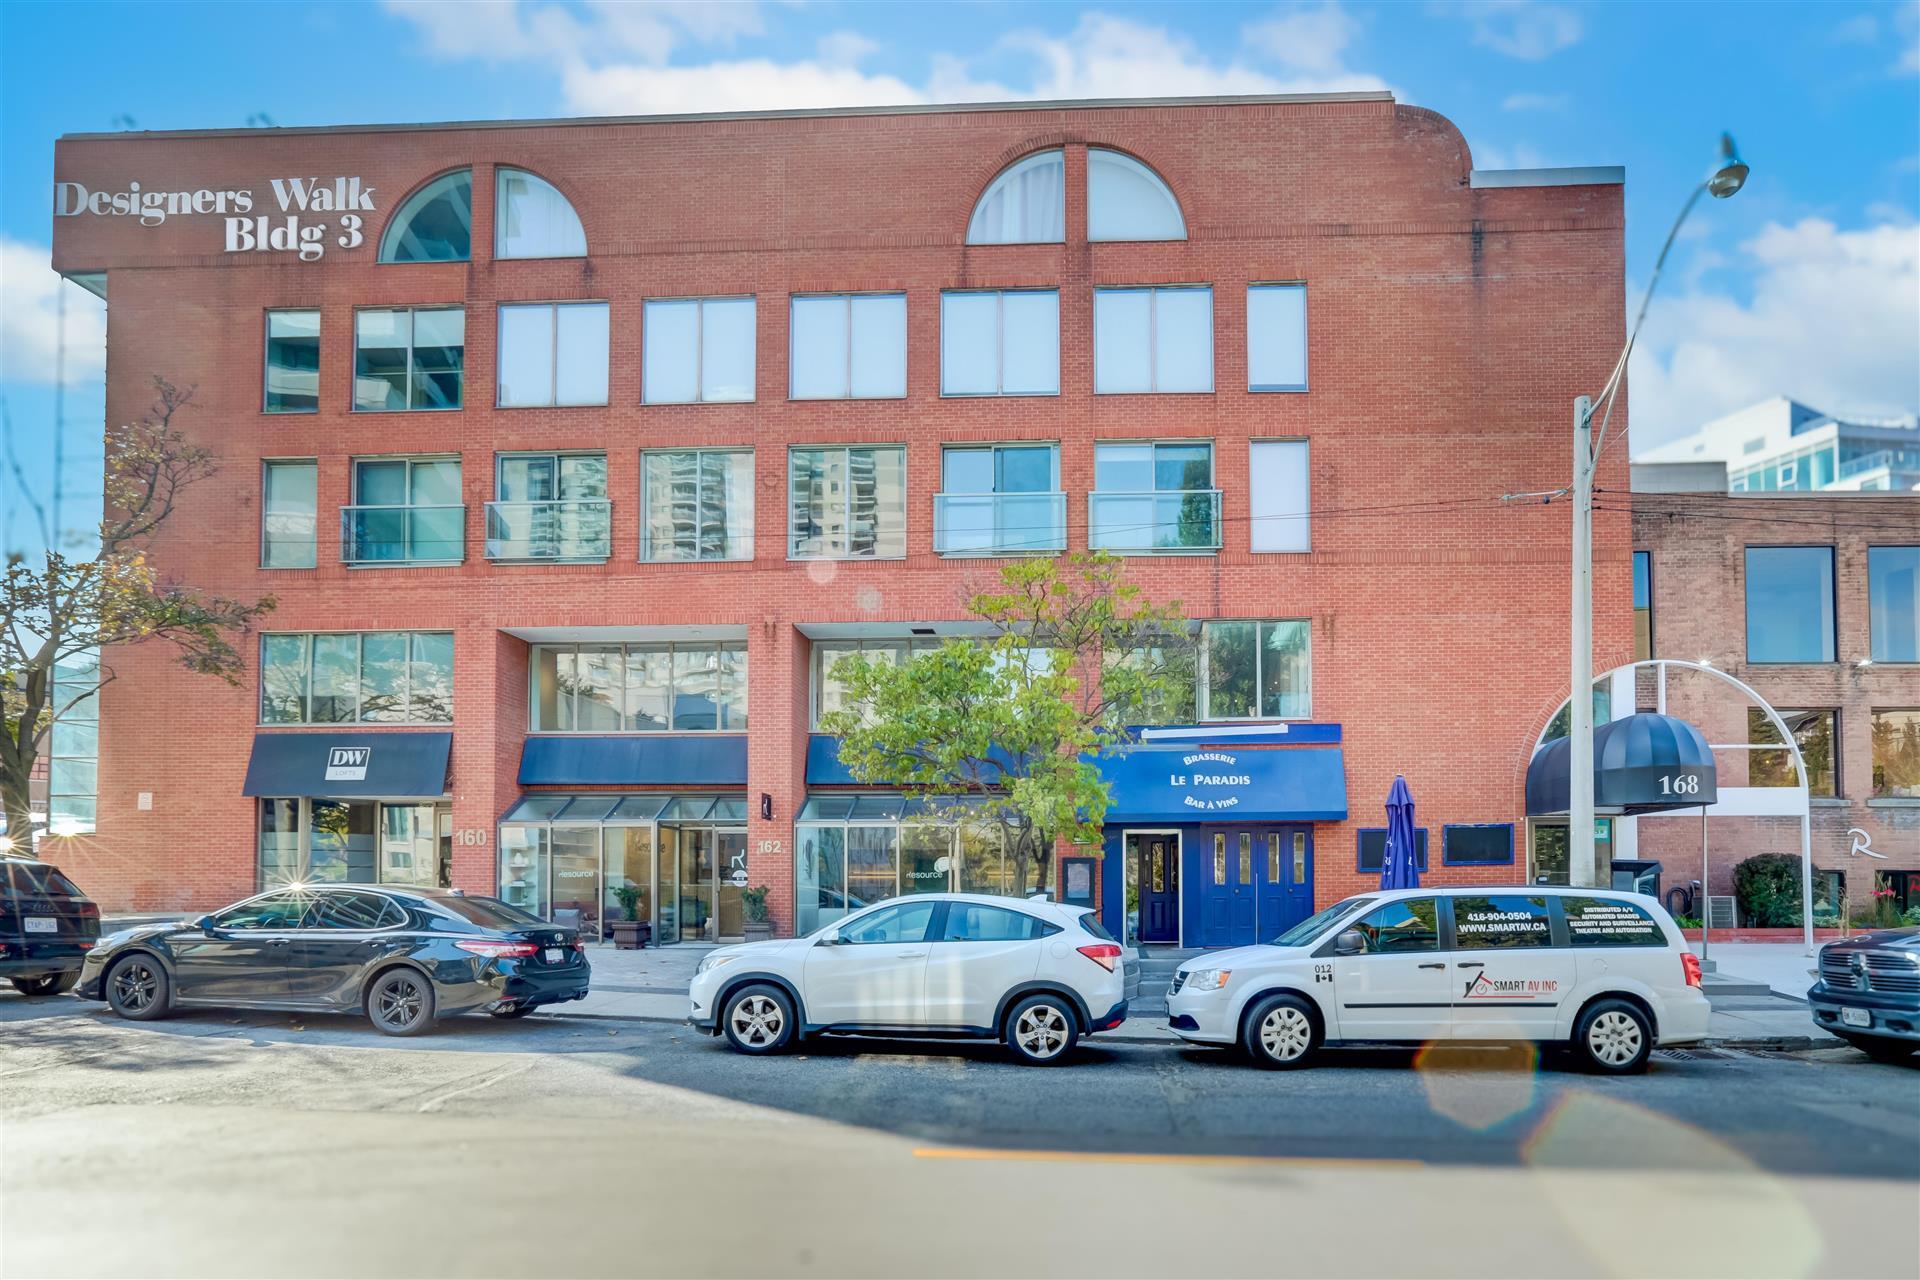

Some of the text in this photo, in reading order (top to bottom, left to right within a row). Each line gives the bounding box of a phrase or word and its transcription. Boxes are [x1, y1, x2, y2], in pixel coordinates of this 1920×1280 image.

[54, 176, 376, 226] Designers Walk
[224, 215, 363, 261] Bldg 3
[332, 750, 366, 765] DW
[1183, 753, 1236, 765] BRASSERIE
[1193, 775, 1251, 785] PARADIS
[1658, 775, 1699, 794] 168
[1184, 796, 1205, 808] BAR
[1216, 796, 1238, 808] VINS
[456, 829, 487, 846] 160
[1847, 828, 1889, 859] R
[757, 840, 781, 854] 162
[1467, 912, 1532, 922] 416-904-0504
[1459, 923, 1546, 933] WWW.SMARTAV.CA
[1314, 964, 1332, 973] 012
[1494, 980, 1558, 991] SMART AV INC
